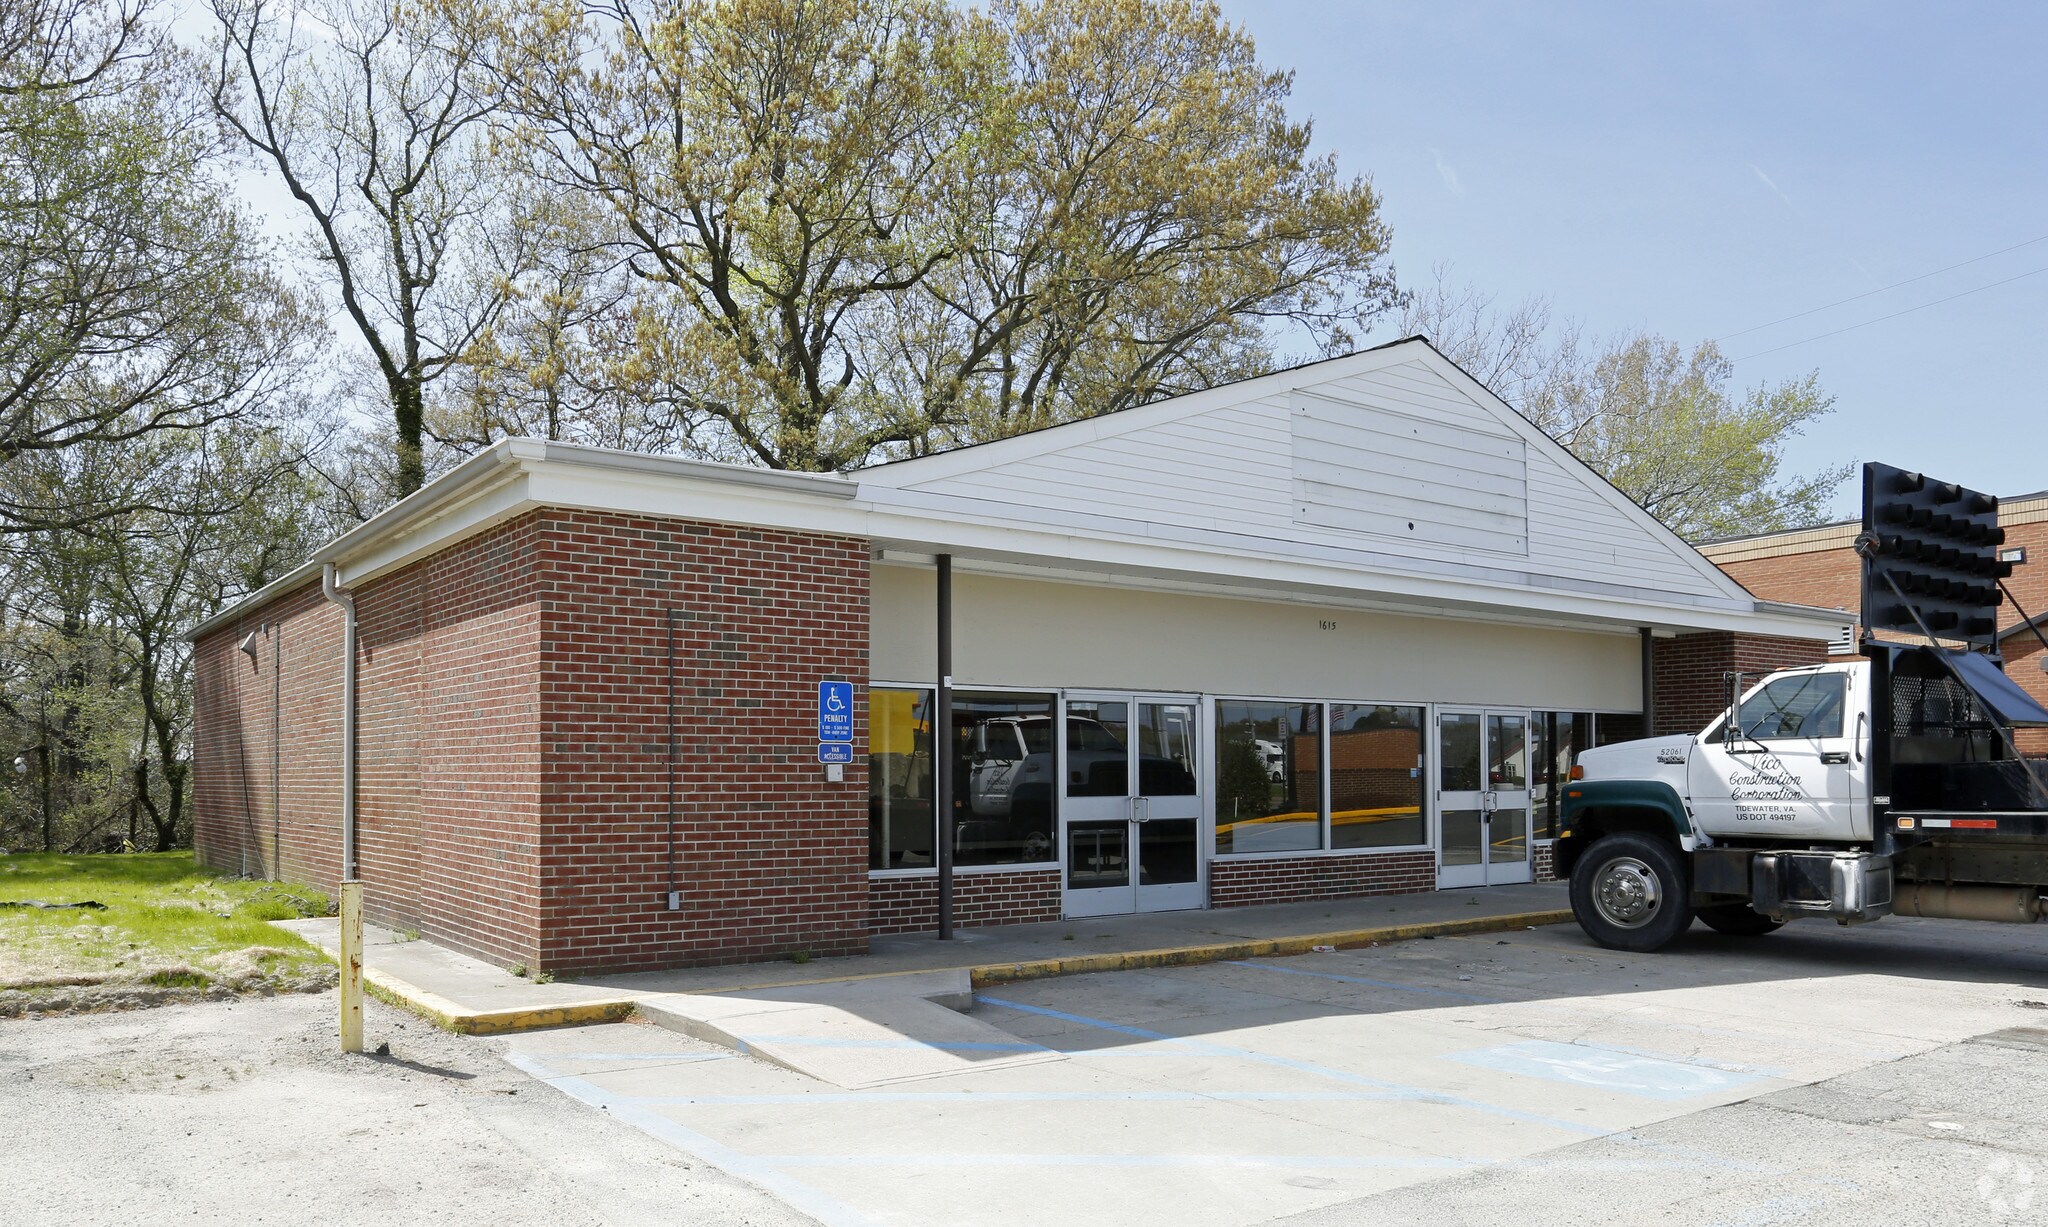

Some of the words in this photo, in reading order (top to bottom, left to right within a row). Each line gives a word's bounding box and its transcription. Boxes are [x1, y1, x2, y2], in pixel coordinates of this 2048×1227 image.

[1319, 620, 1337, 631] 1615
[823, 714, 848, 723] PENALTY
[1660, 748, 1682, 756] 52061
[1752, 753, 1782, 771] Vico
[1729, 771, 1803, 786] Construction
[1731, 786, 1803, 801] Corporation
[1735, 805, 1782, 813] TIDEWATER,
[1783, 805, 1797, 813] VA.
[1736, 813, 1748, 821] US
[1749, 813, 1767, 821] DOT
[1769, 813, 1796, 821] 494197
